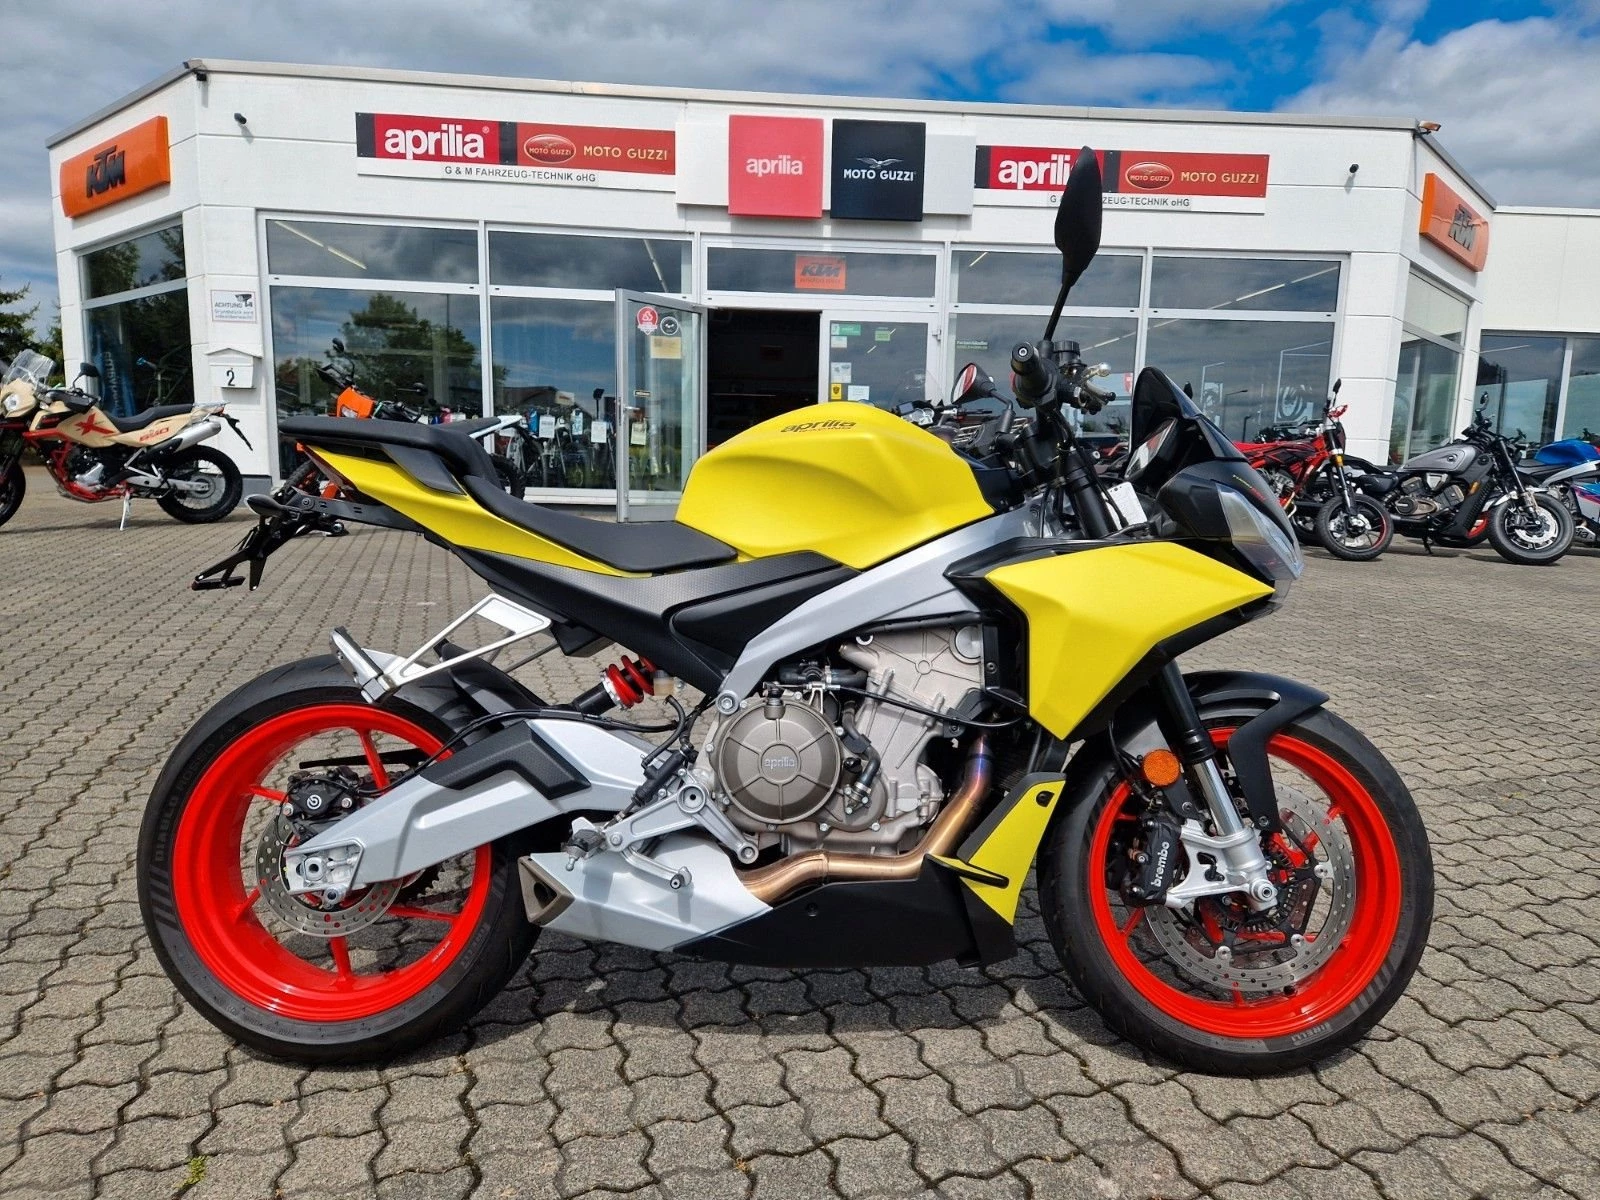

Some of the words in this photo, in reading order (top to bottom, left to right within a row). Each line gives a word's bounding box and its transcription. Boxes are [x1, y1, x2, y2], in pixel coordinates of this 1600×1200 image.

[384, 123, 485, 160] aprilia
[550, 148, 571, 156] GUZZI
[583, 145, 622, 158] MOTO
[626, 148, 667, 161] GUZZI
[86, 144, 126, 198] KTM
[444, 165, 453, 175] G
[455, 166, 462, 175] &
[464, 167, 473, 176] M
[475, 168, 573, 181] FAHRZEUG-TECHNIK
[576, 173, 596, 182] oHG
[745, 155, 803, 177] aprilia
[998, 153, 1078, 190] aprili
[843, 168, 876, 180] MOTO
[879, 169, 914, 182] GUZZI
[1180, 171, 1217, 183] MOTO
[1221, 173, 1259, 184] GUZZI
[1049, 194, 1057, 203] G
[1102, 196, 1169, 207] ZEUG-TECHNIK
[1171, 198, 1190, 207] oHG
[1447, 204, 1476, 252] KTM
[801, 262, 841, 277] KTM
[226, 369, 236, 387] 2
[780, 419, 857, 433] aprilia
[763, 756, 795, 770] aprilia
[1150, 841, 1170, 888] brembo
